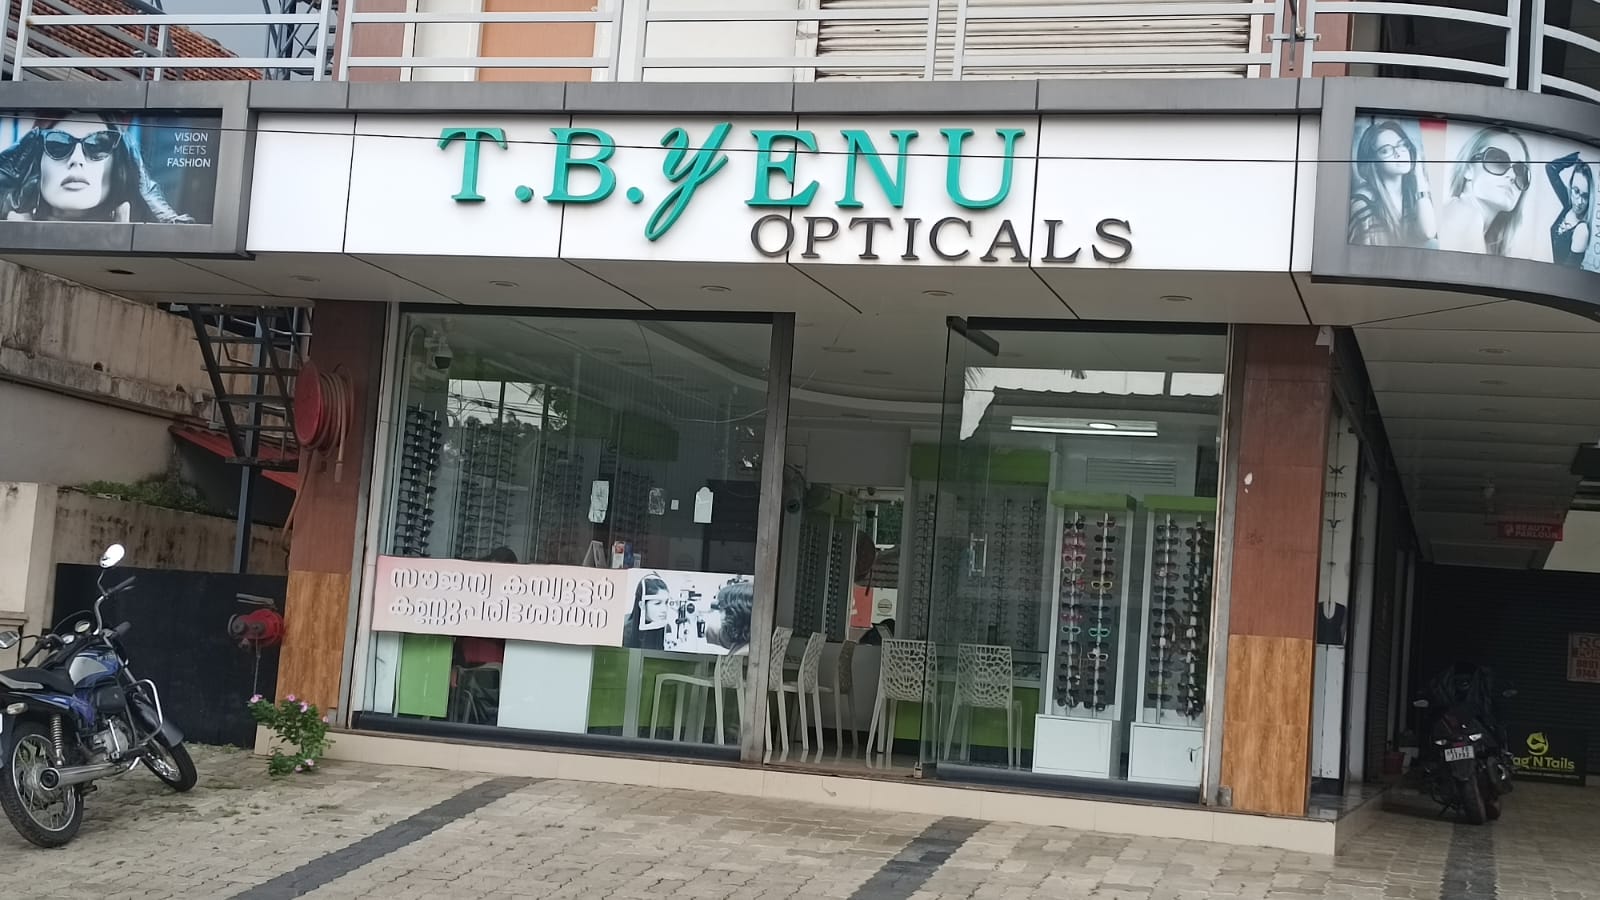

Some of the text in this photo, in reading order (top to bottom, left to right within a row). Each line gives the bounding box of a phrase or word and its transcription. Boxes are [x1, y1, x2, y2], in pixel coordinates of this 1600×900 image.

[174, 132, 209, 142] VISION
[173, 145, 207, 155] MEETS
[166, 157, 211, 168] FASHION
[750, 214, 1133, 263] OPTICALS
[1544, 757, 1576, 770] Tails
